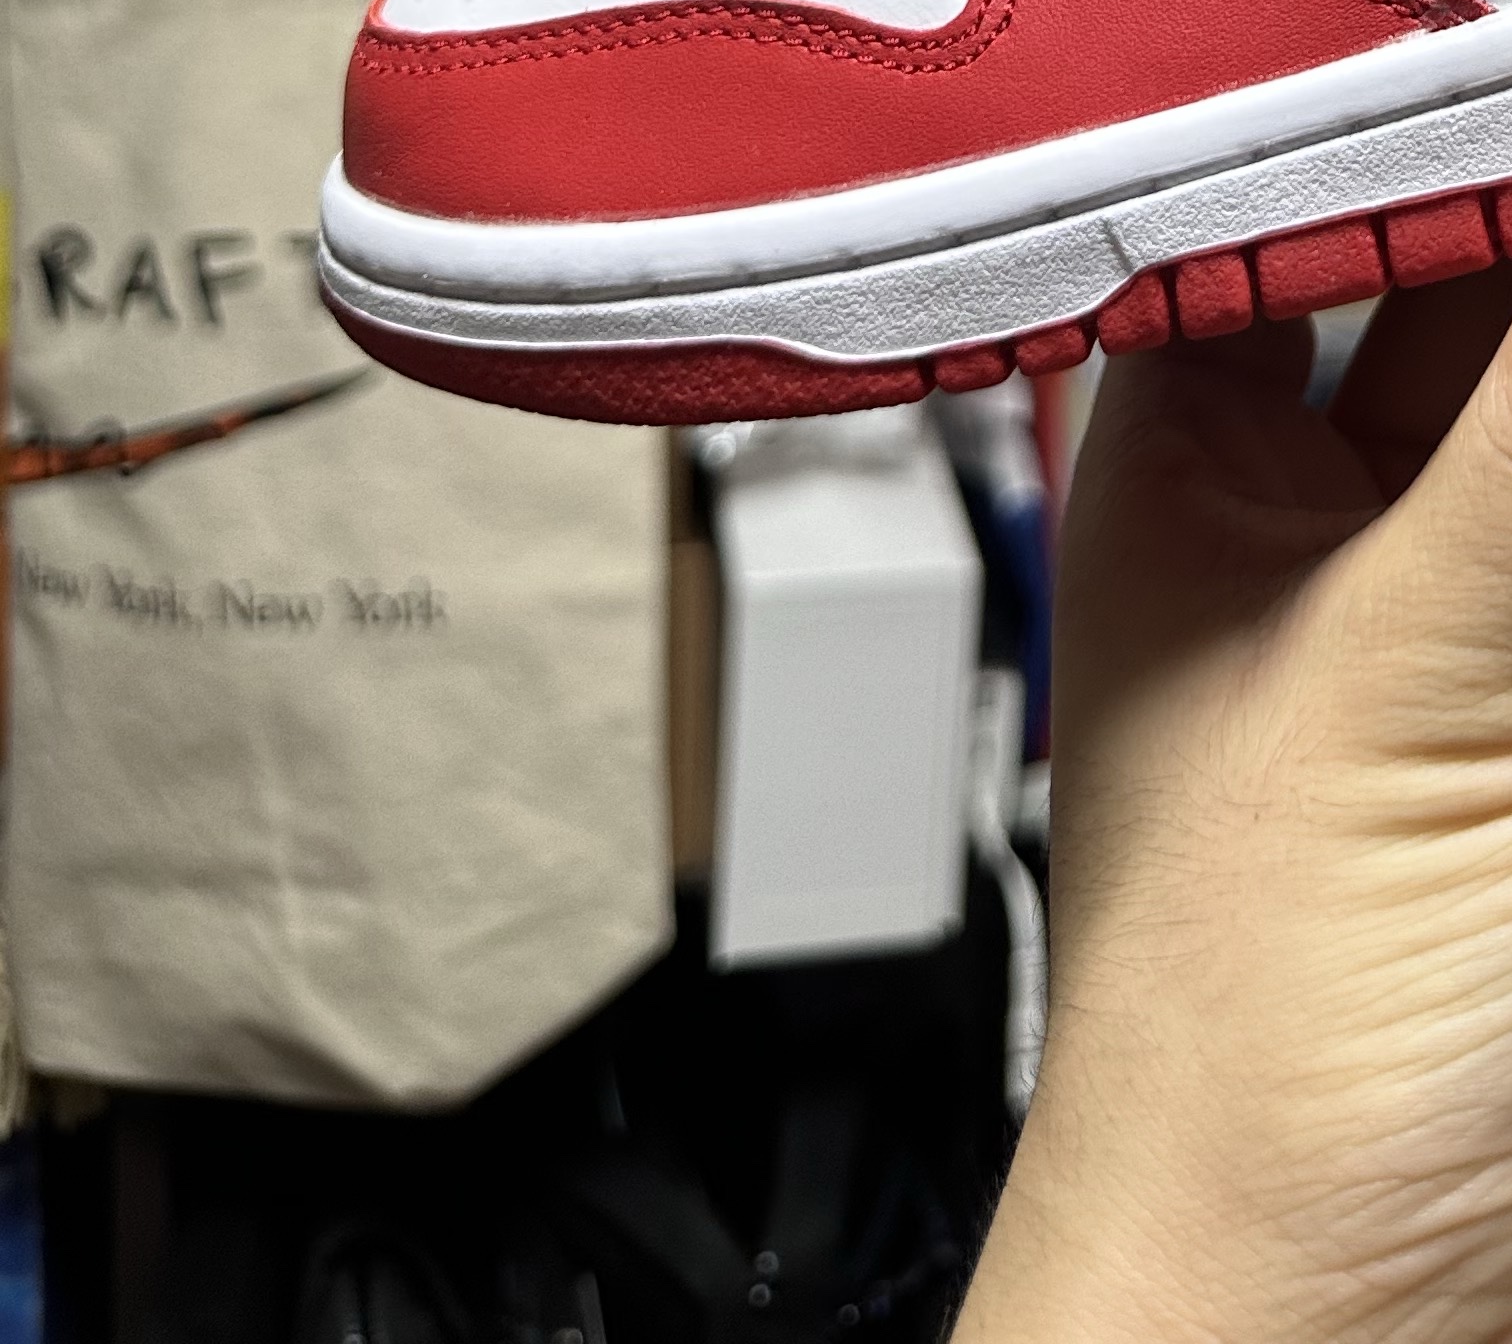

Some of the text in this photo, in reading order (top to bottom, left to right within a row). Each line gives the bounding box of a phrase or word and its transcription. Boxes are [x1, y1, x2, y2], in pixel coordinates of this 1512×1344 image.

[34, 224, 320, 328] RAF
[212, 578, 322, 628] New
[330, 576, 448, 628] York
